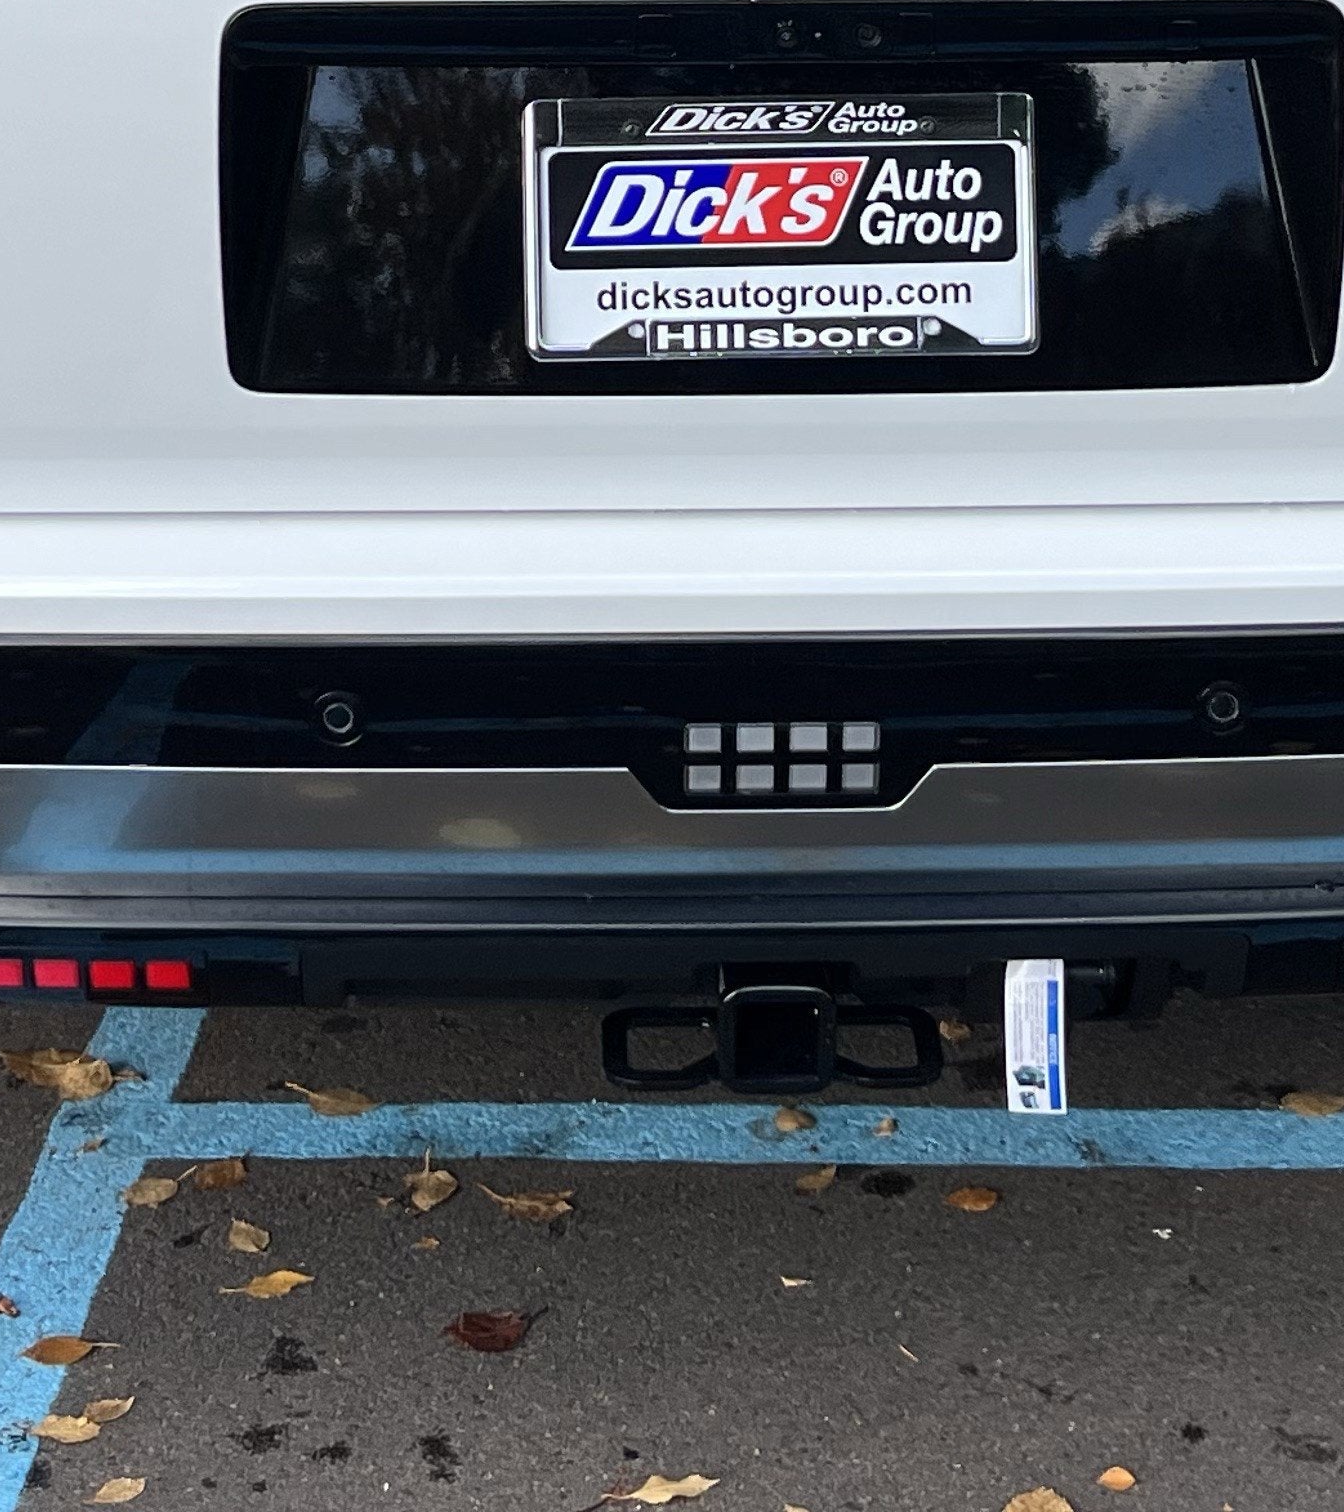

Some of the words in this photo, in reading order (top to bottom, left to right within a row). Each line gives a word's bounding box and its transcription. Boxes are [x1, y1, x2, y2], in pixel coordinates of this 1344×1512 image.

[834, 101, 906, 119] Auto
[827, 116, 918, 136] Group
[867, 158, 982, 202] Auto
[858, 202, 1003, 253] Group
[596, 278, 972, 312] dicksautogroup.com
[655, 321, 915, 350] Hillsboro
